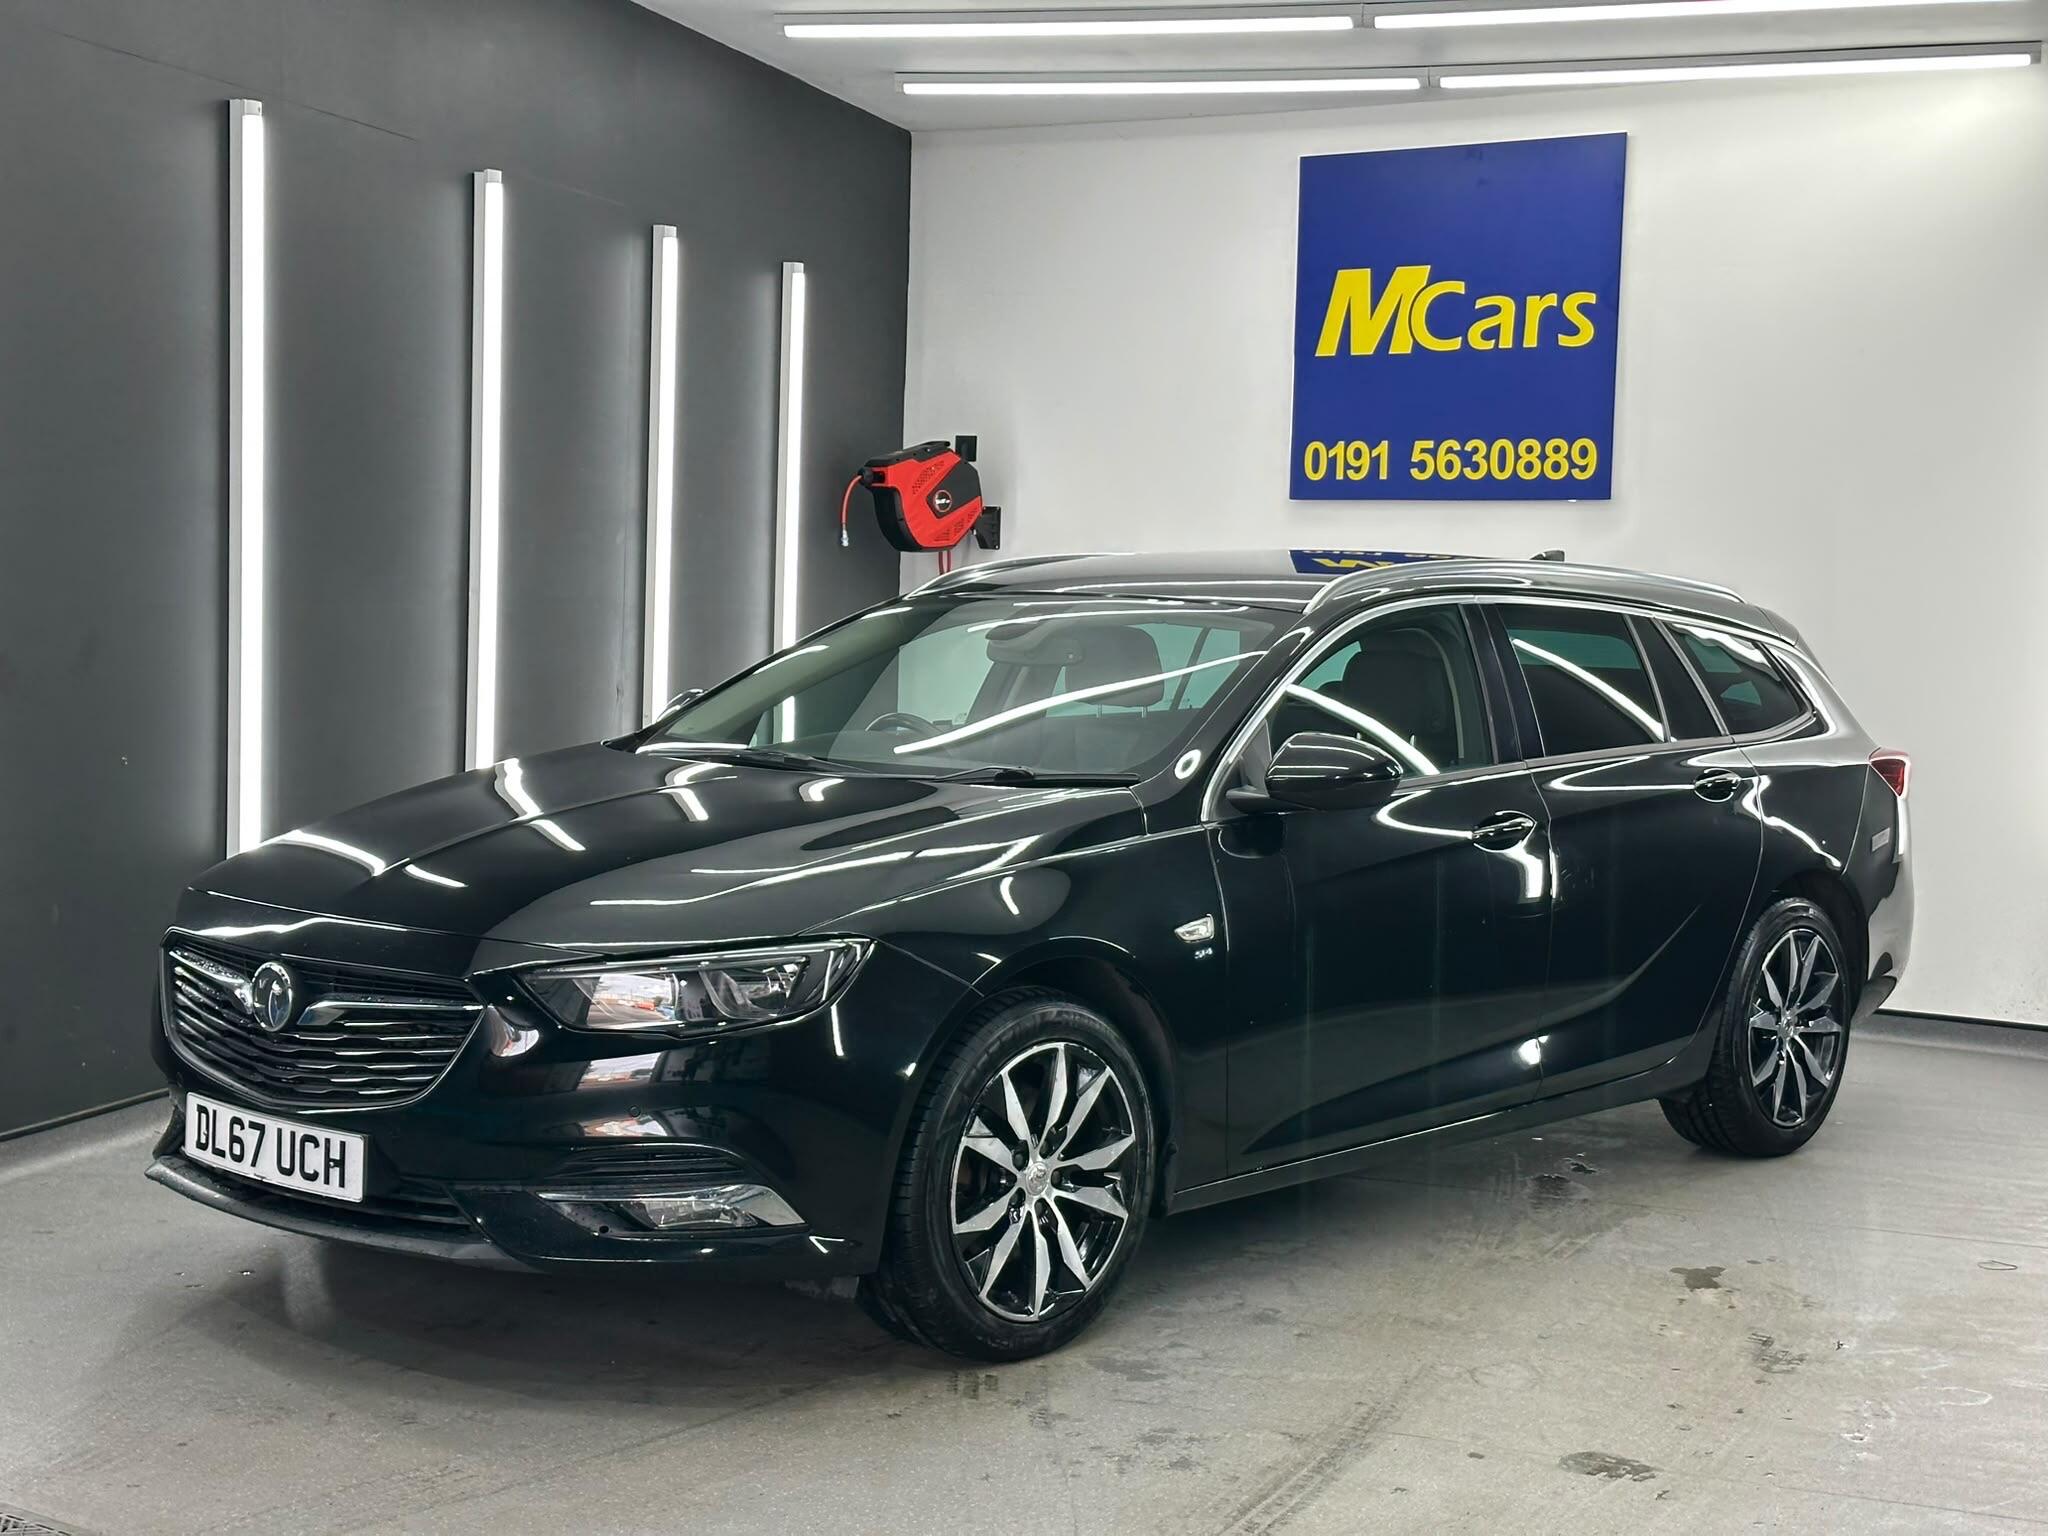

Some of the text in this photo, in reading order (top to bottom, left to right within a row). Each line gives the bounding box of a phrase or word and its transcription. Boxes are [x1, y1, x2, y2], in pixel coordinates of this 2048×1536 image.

[1315, 265, 1597, 357] MCars
[1304, 438, 1597, 481] 0191 5630889
[196, 1104, 346, 1188] DL67 UCH
